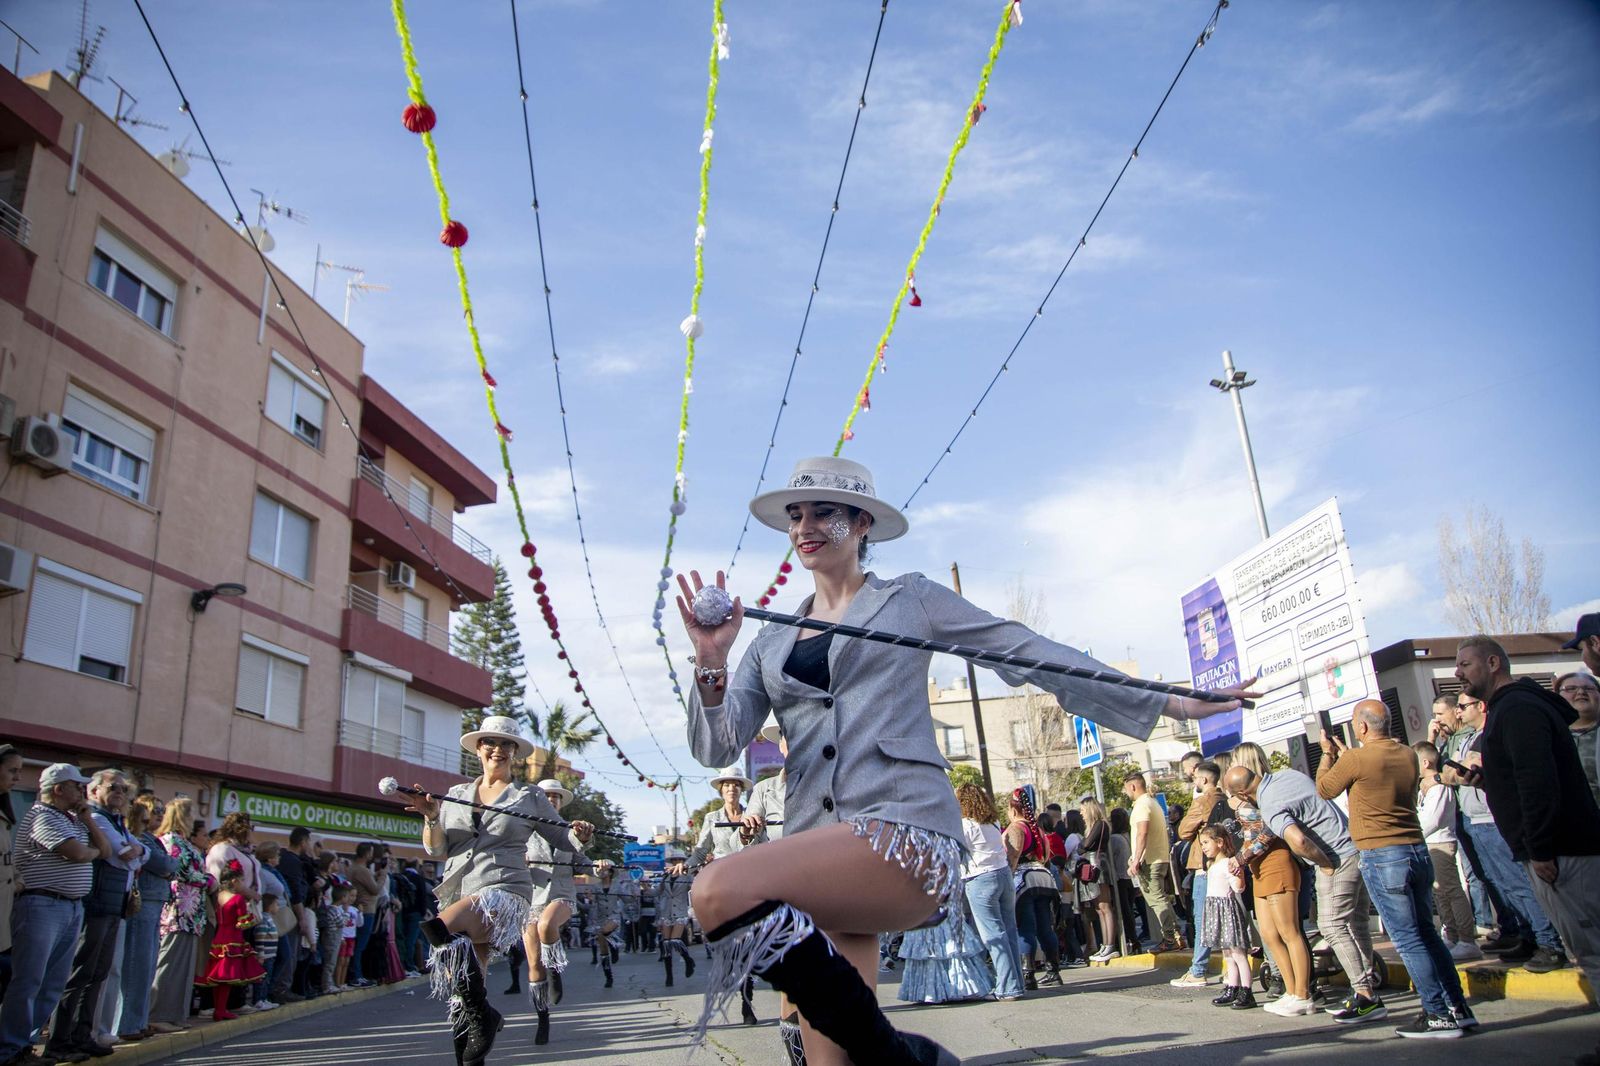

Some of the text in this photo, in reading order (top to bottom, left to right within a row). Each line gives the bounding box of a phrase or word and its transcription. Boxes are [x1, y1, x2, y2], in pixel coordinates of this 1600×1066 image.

[1262, 558, 1306, 588] EN BENAHADUX
[1313, 582, 1321, 597] €
[1264, 658, 1292, 675] MAYGAR
[1259, 708, 1291, 726] SEPTIEMBRE
[246, 797, 301, 820] CENTRO
[306, 806, 352, 825] OPTICO
